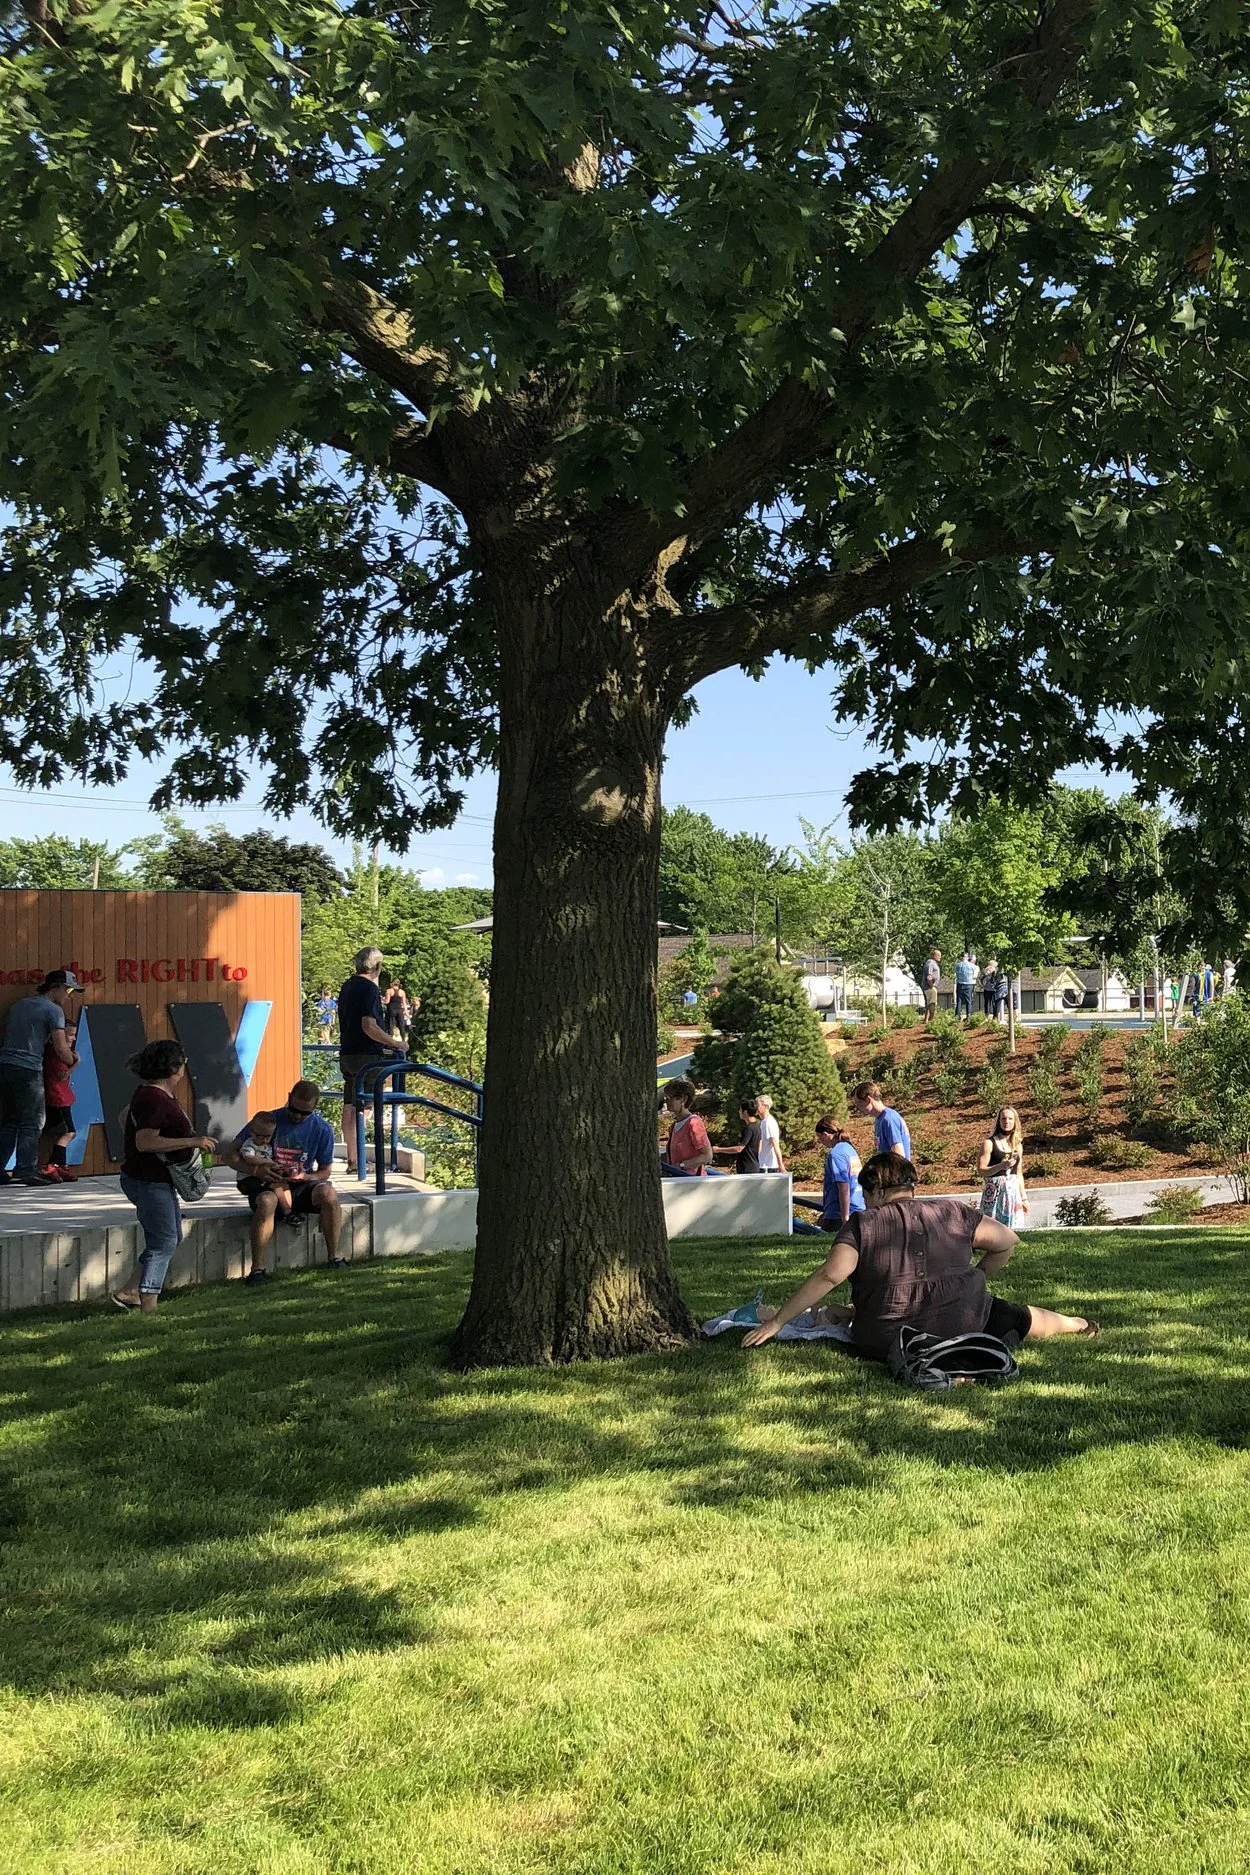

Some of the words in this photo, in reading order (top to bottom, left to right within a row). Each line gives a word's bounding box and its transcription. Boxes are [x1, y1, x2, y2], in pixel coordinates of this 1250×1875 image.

[60, 961, 106, 984] he
[117, 957, 219, 983] RIGHT
[222, 963, 248, 981] to
